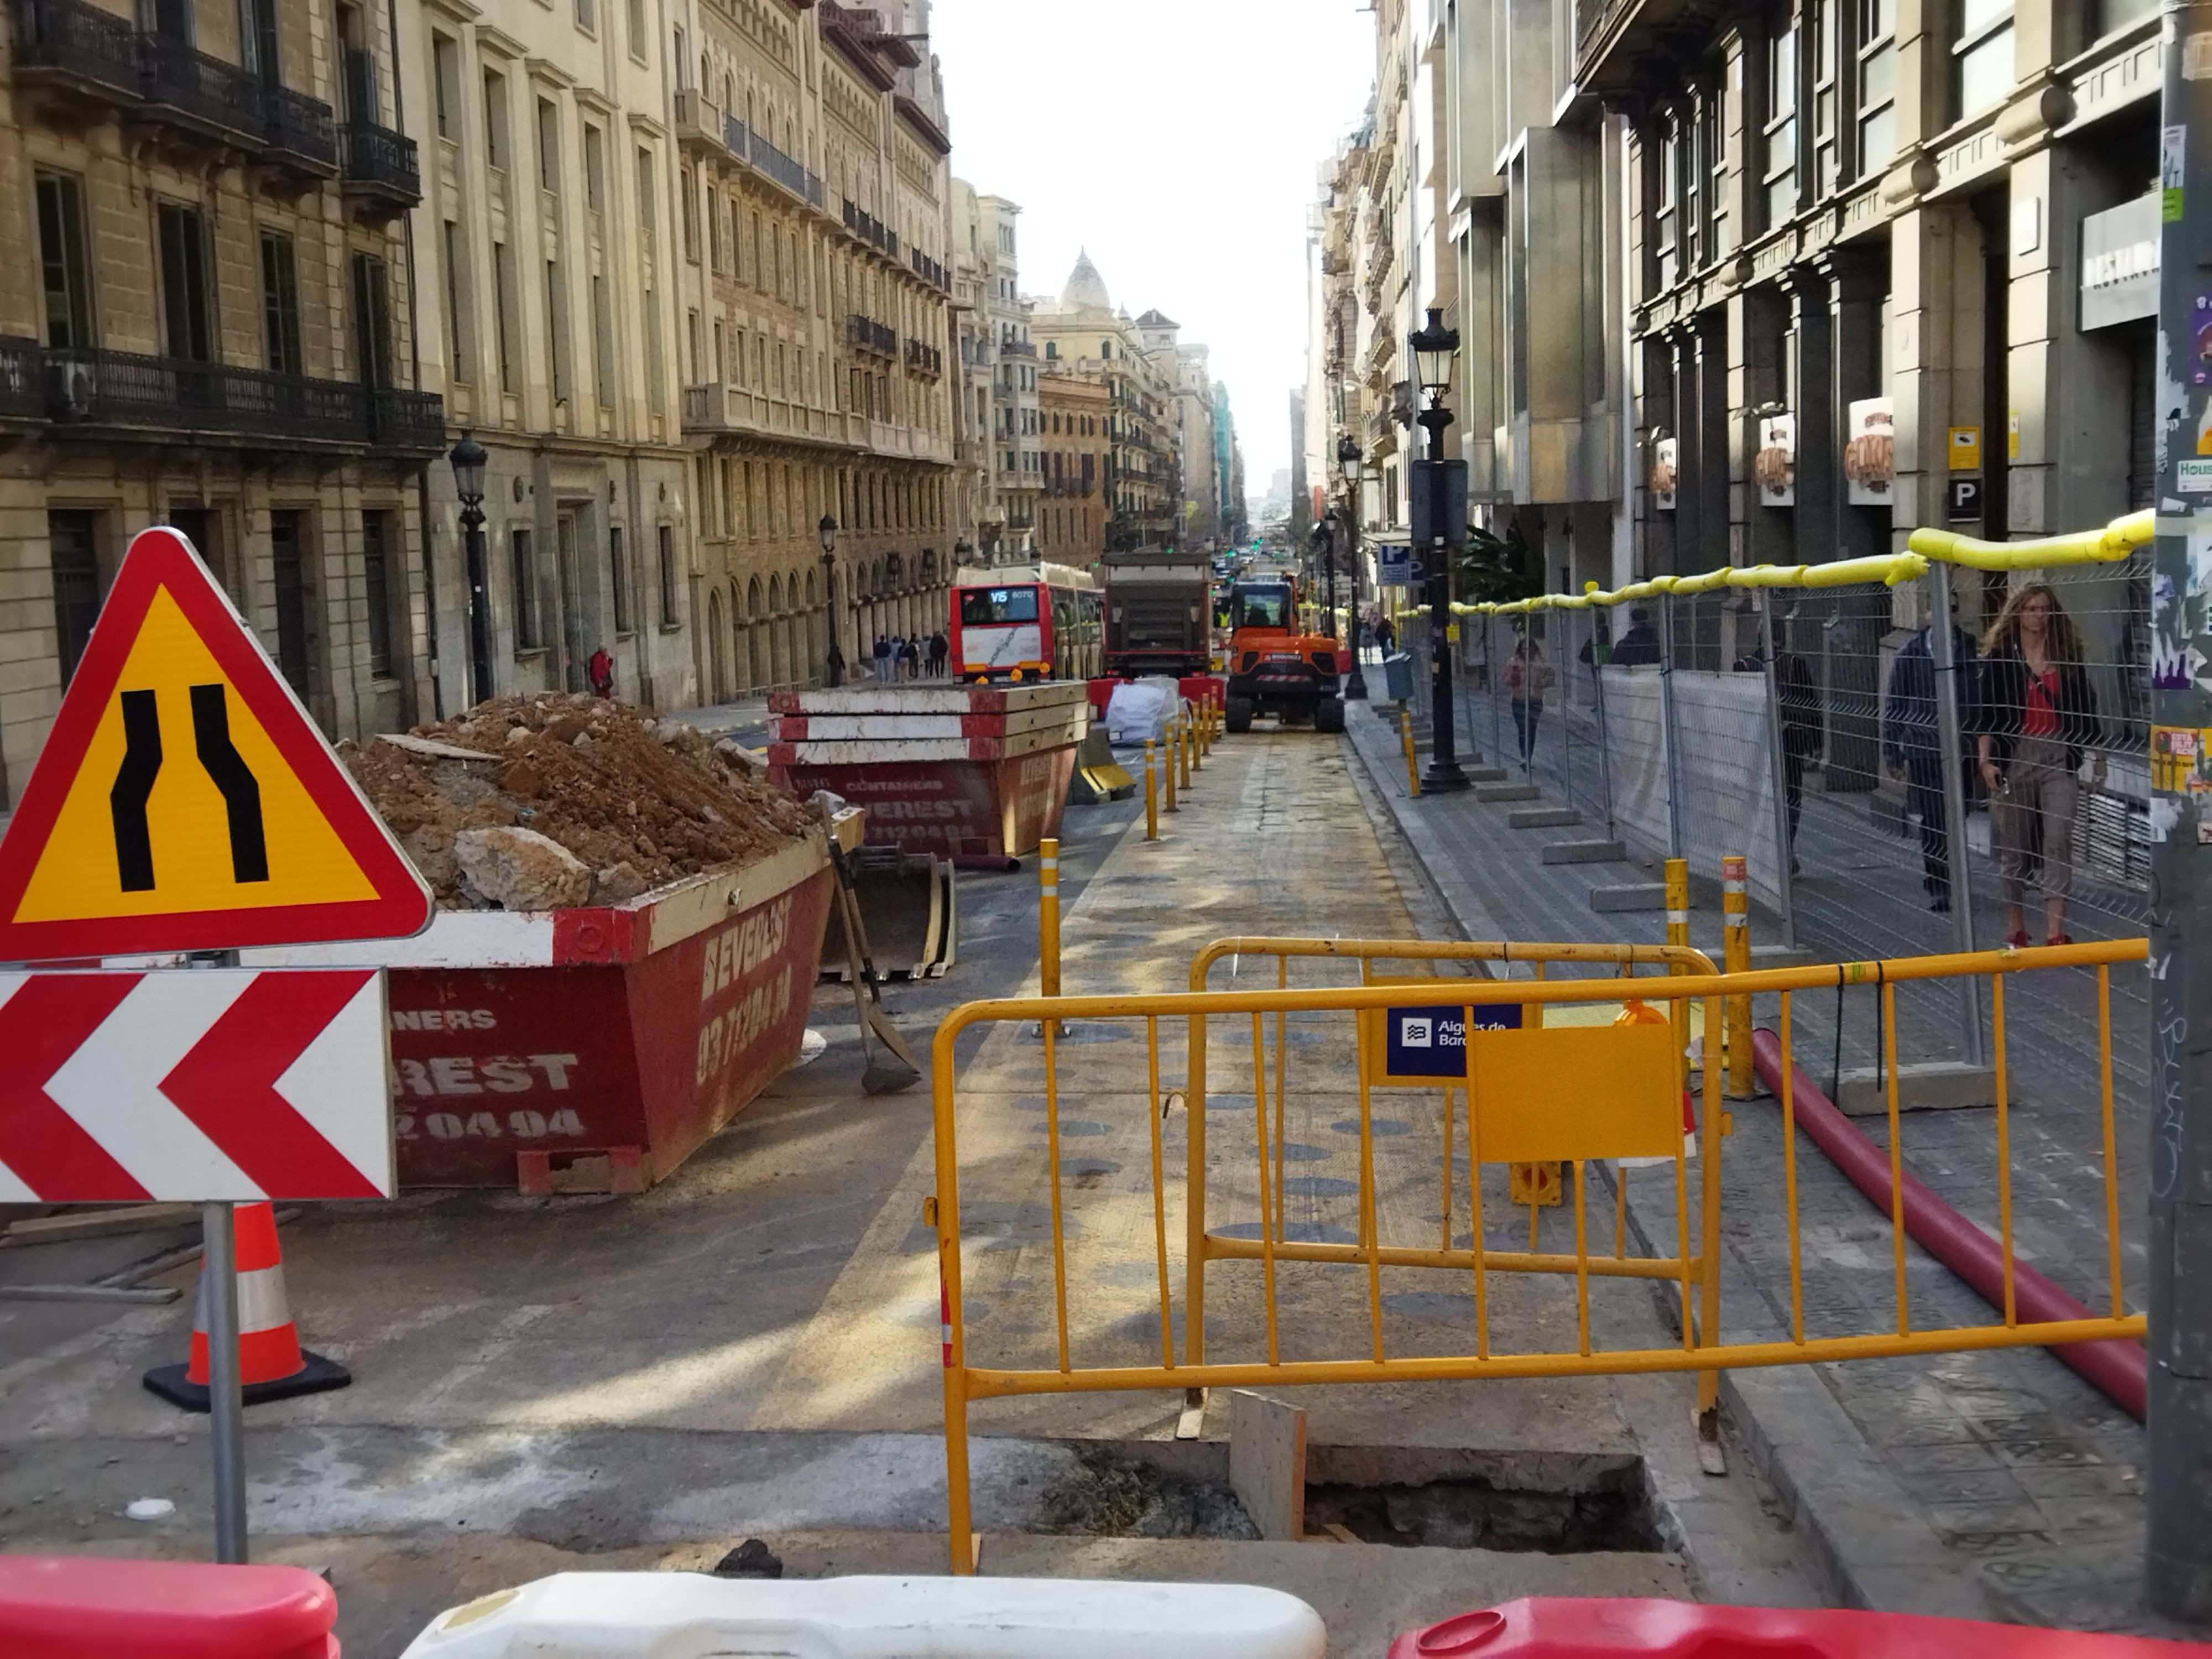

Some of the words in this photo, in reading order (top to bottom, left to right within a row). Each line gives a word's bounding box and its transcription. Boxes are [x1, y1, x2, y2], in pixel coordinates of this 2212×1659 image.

[1957, 483, 1976, 507] P
[1387, 546, 1404, 561] P
[1407, 561, 1423, 580] P
[390, 1009, 497, 1030] NERS
